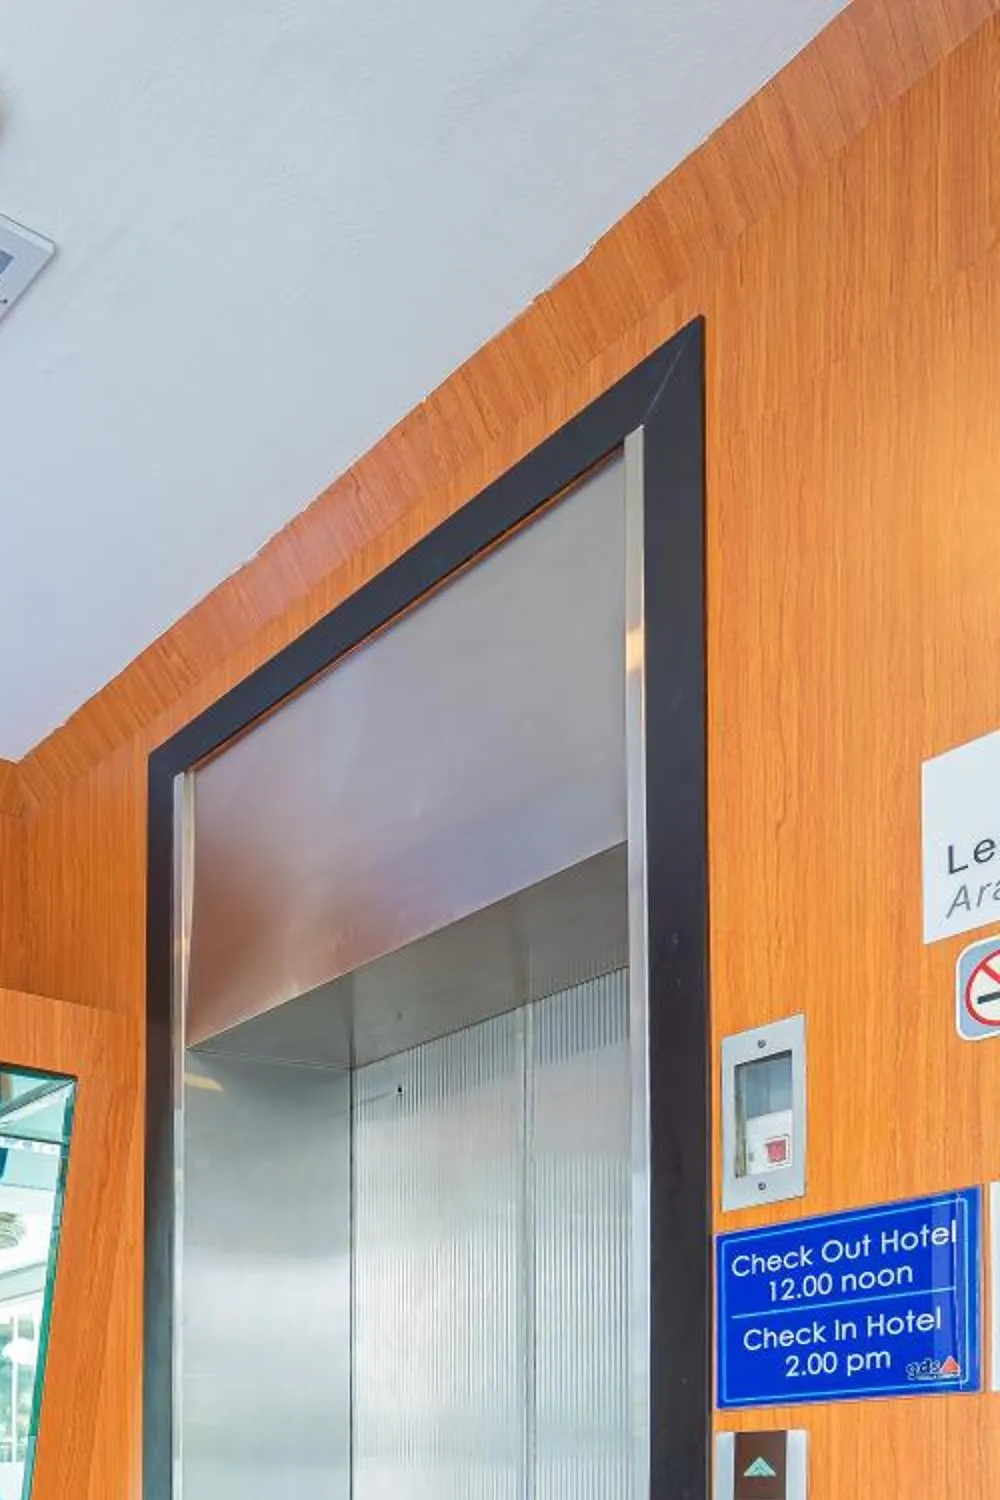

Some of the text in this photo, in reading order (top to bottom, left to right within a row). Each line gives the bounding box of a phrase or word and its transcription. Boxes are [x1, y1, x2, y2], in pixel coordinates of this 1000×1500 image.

[731, 1219, 957, 1277] Check Out Hotel
[769, 1265, 913, 1302] 12.00 noon
[743, 1305, 941, 1351] Check In Hotel
[785, 1353, 837, 1377] 2.00
[847, 1351, 891, 1376] pm
